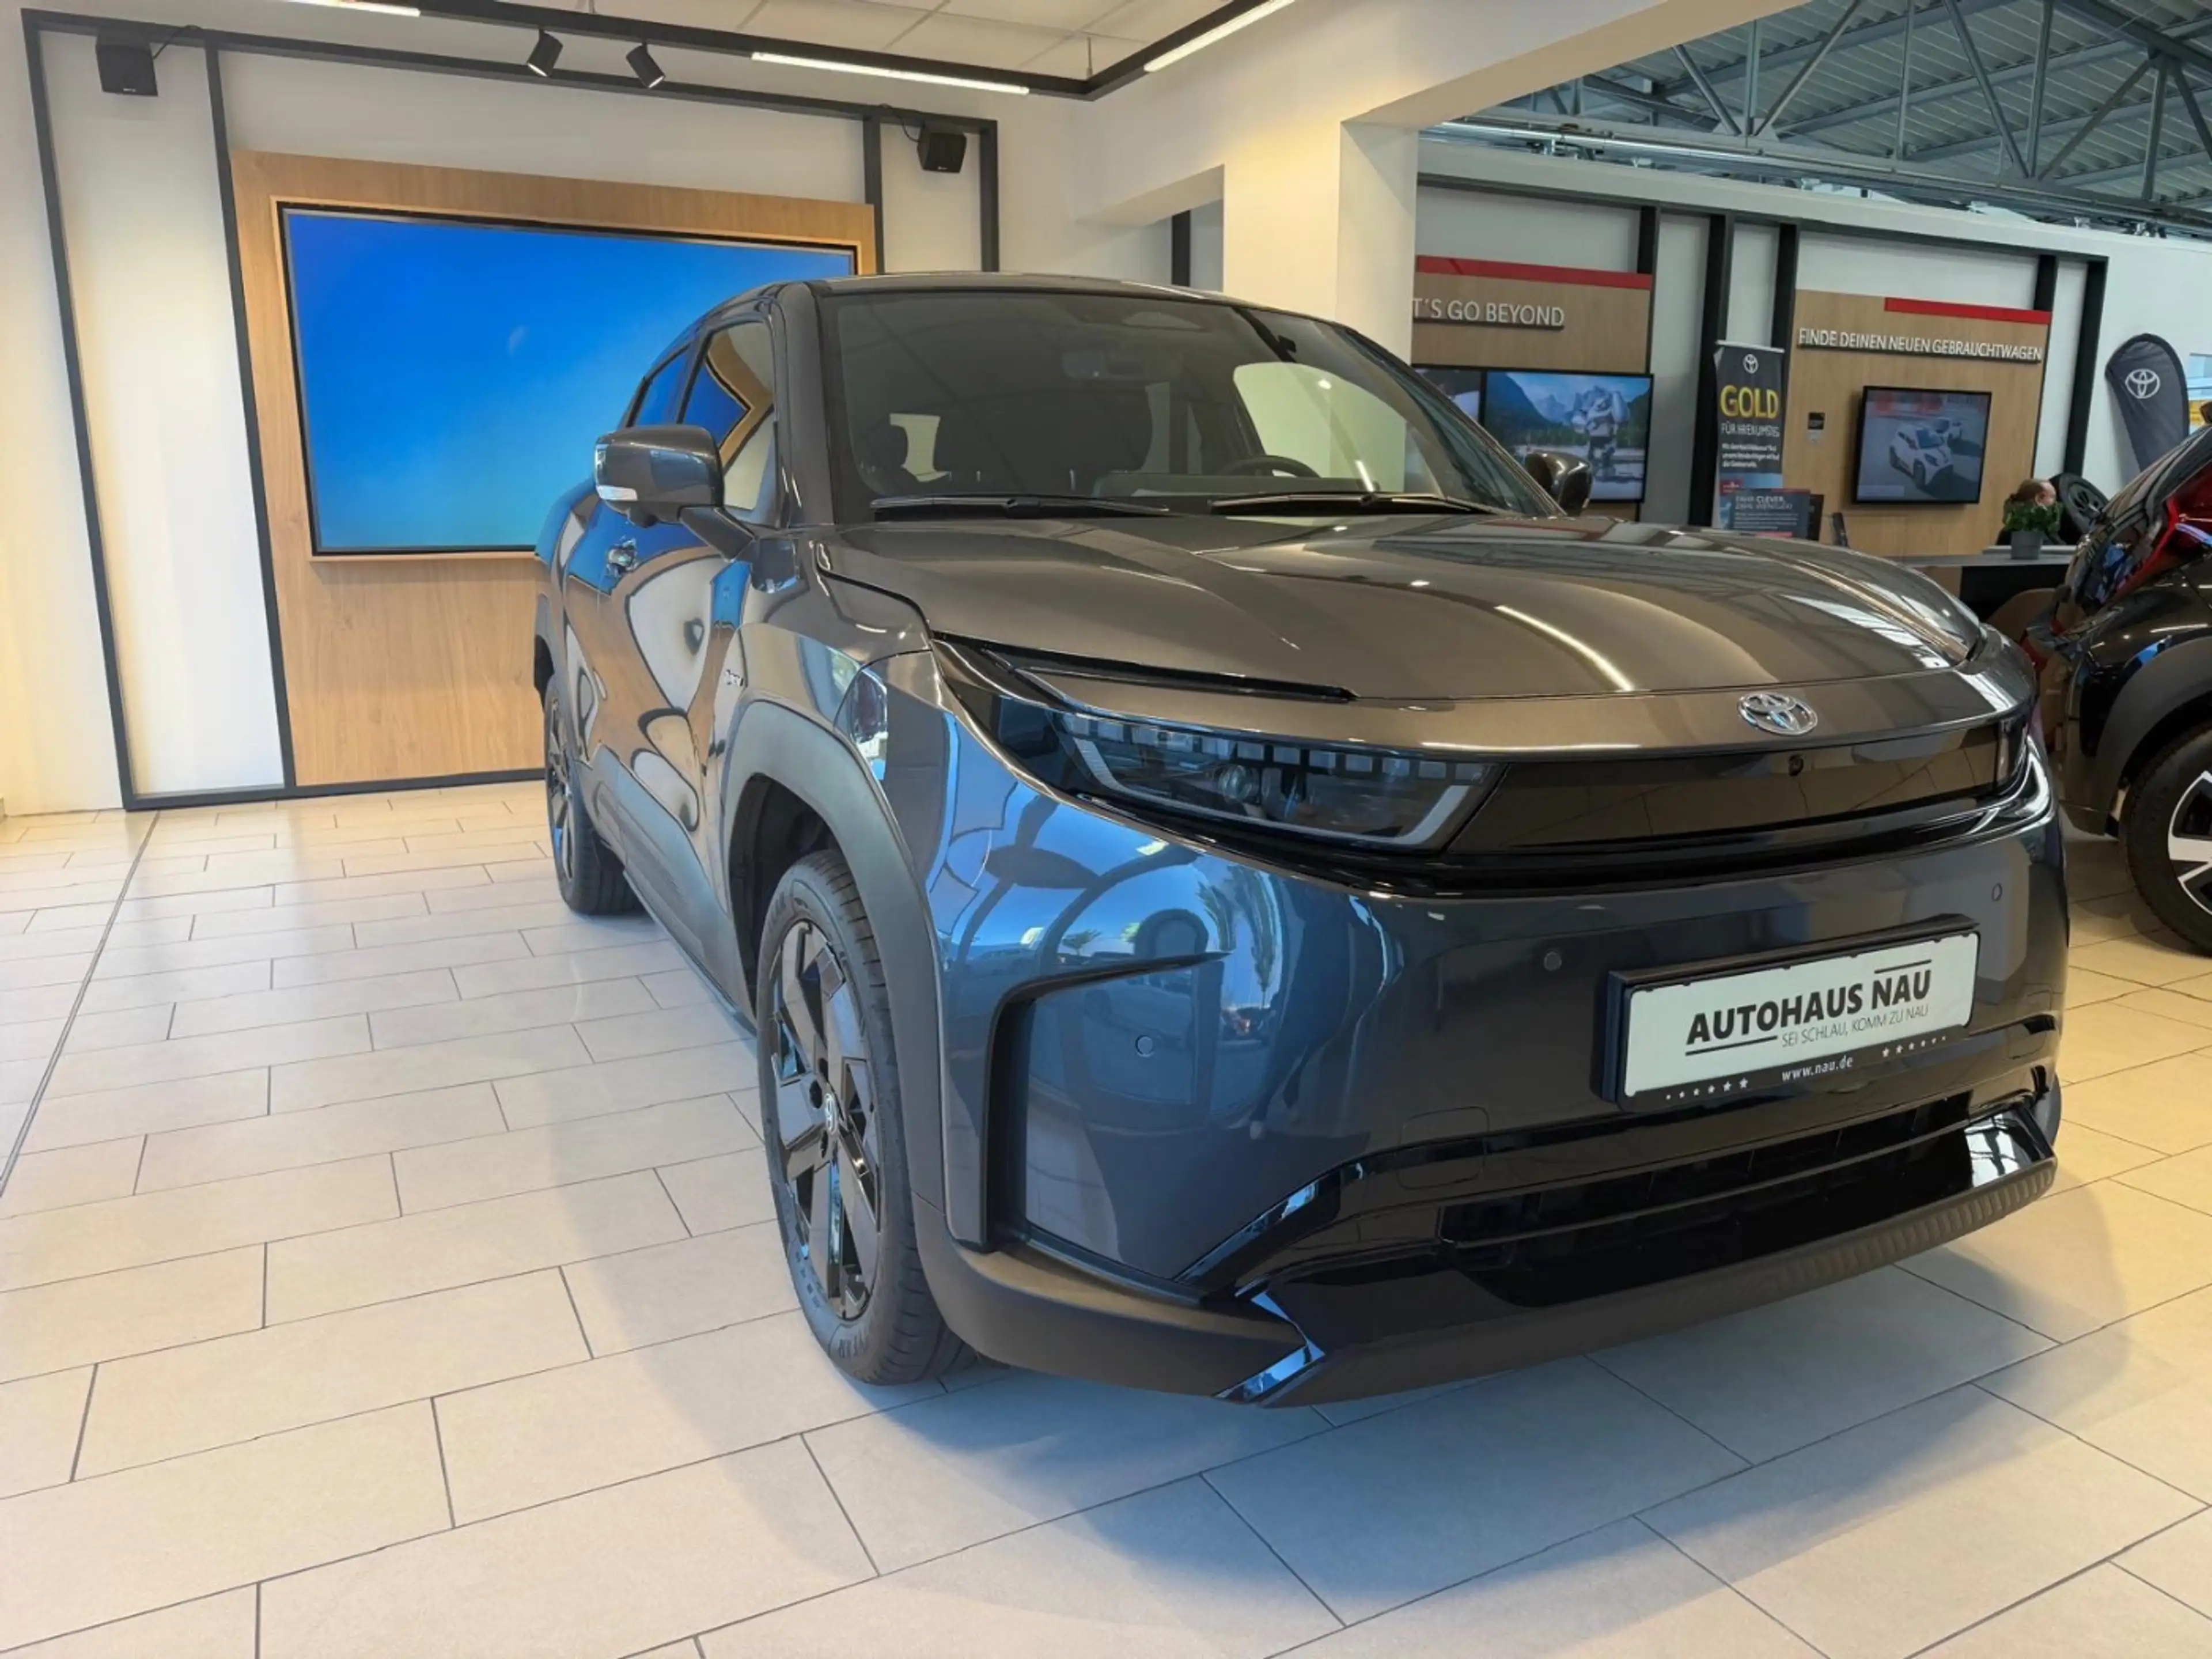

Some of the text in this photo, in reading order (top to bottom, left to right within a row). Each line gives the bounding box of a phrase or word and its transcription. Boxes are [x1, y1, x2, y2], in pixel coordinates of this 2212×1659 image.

[1447, 300, 1480, 321] GO
[1486, 302, 1565, 327] BEYOND
[1798, 327, 2043, 360] FINDE DEINEN NEUEN GEBRAUCHTWAGEN
[1719, 384, 1779, 419] GOLD
[1685, 969, 1932, 1046] AUTOHAUS NAU
[1781, 1004, 1929, 1048] SEI SCHLAU, KOMM ZU NAU
[1781, 1055, 1854, 1082] www.nau.de
